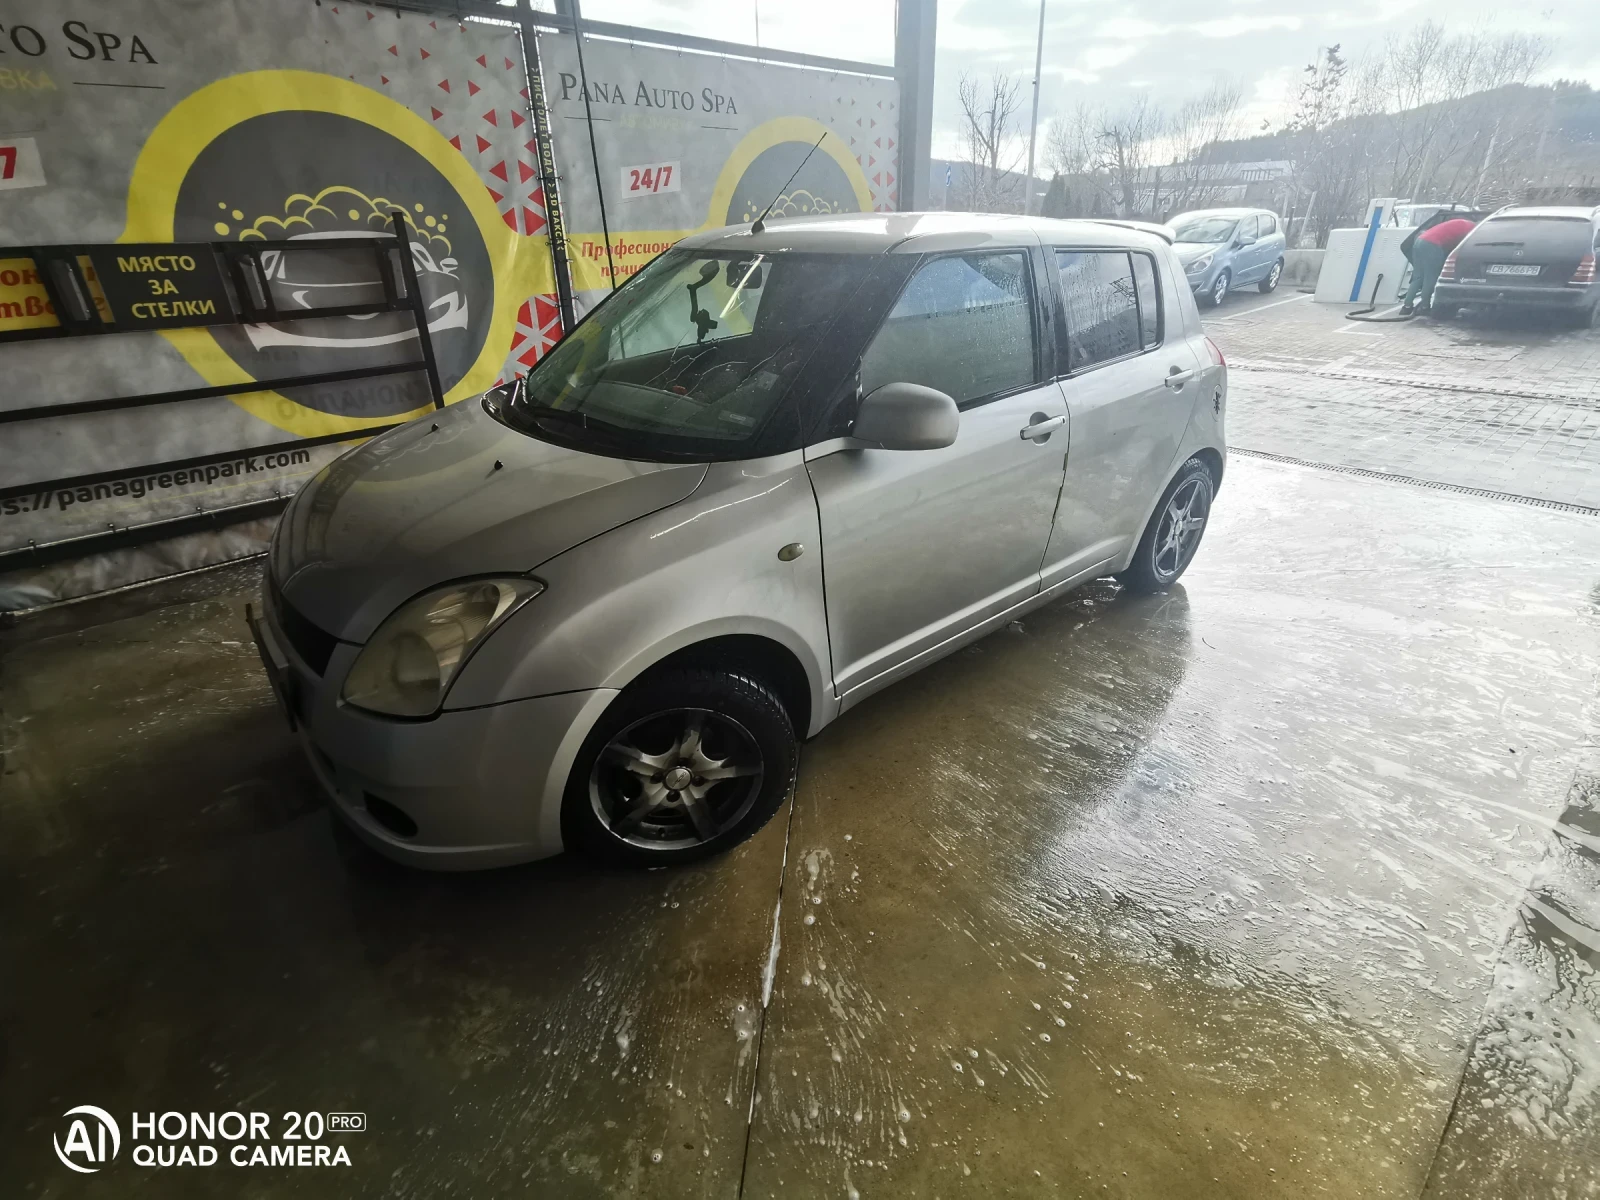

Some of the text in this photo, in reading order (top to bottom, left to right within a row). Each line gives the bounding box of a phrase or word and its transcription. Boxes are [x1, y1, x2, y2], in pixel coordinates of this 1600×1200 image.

[532, 76, 553, 174] ПИСТОЛЕТ ВОДА
[630, 166, 673, 193] 24/7
[549, 193, 558, 206] 3D
[117, 255, 196, 272] МЯСТО
[148, 279, 179, 295] ЗА
[131, 299, 216, 319] СТЕЛКИ
[0, 450, 310, 516] s://panagreenpark.com
